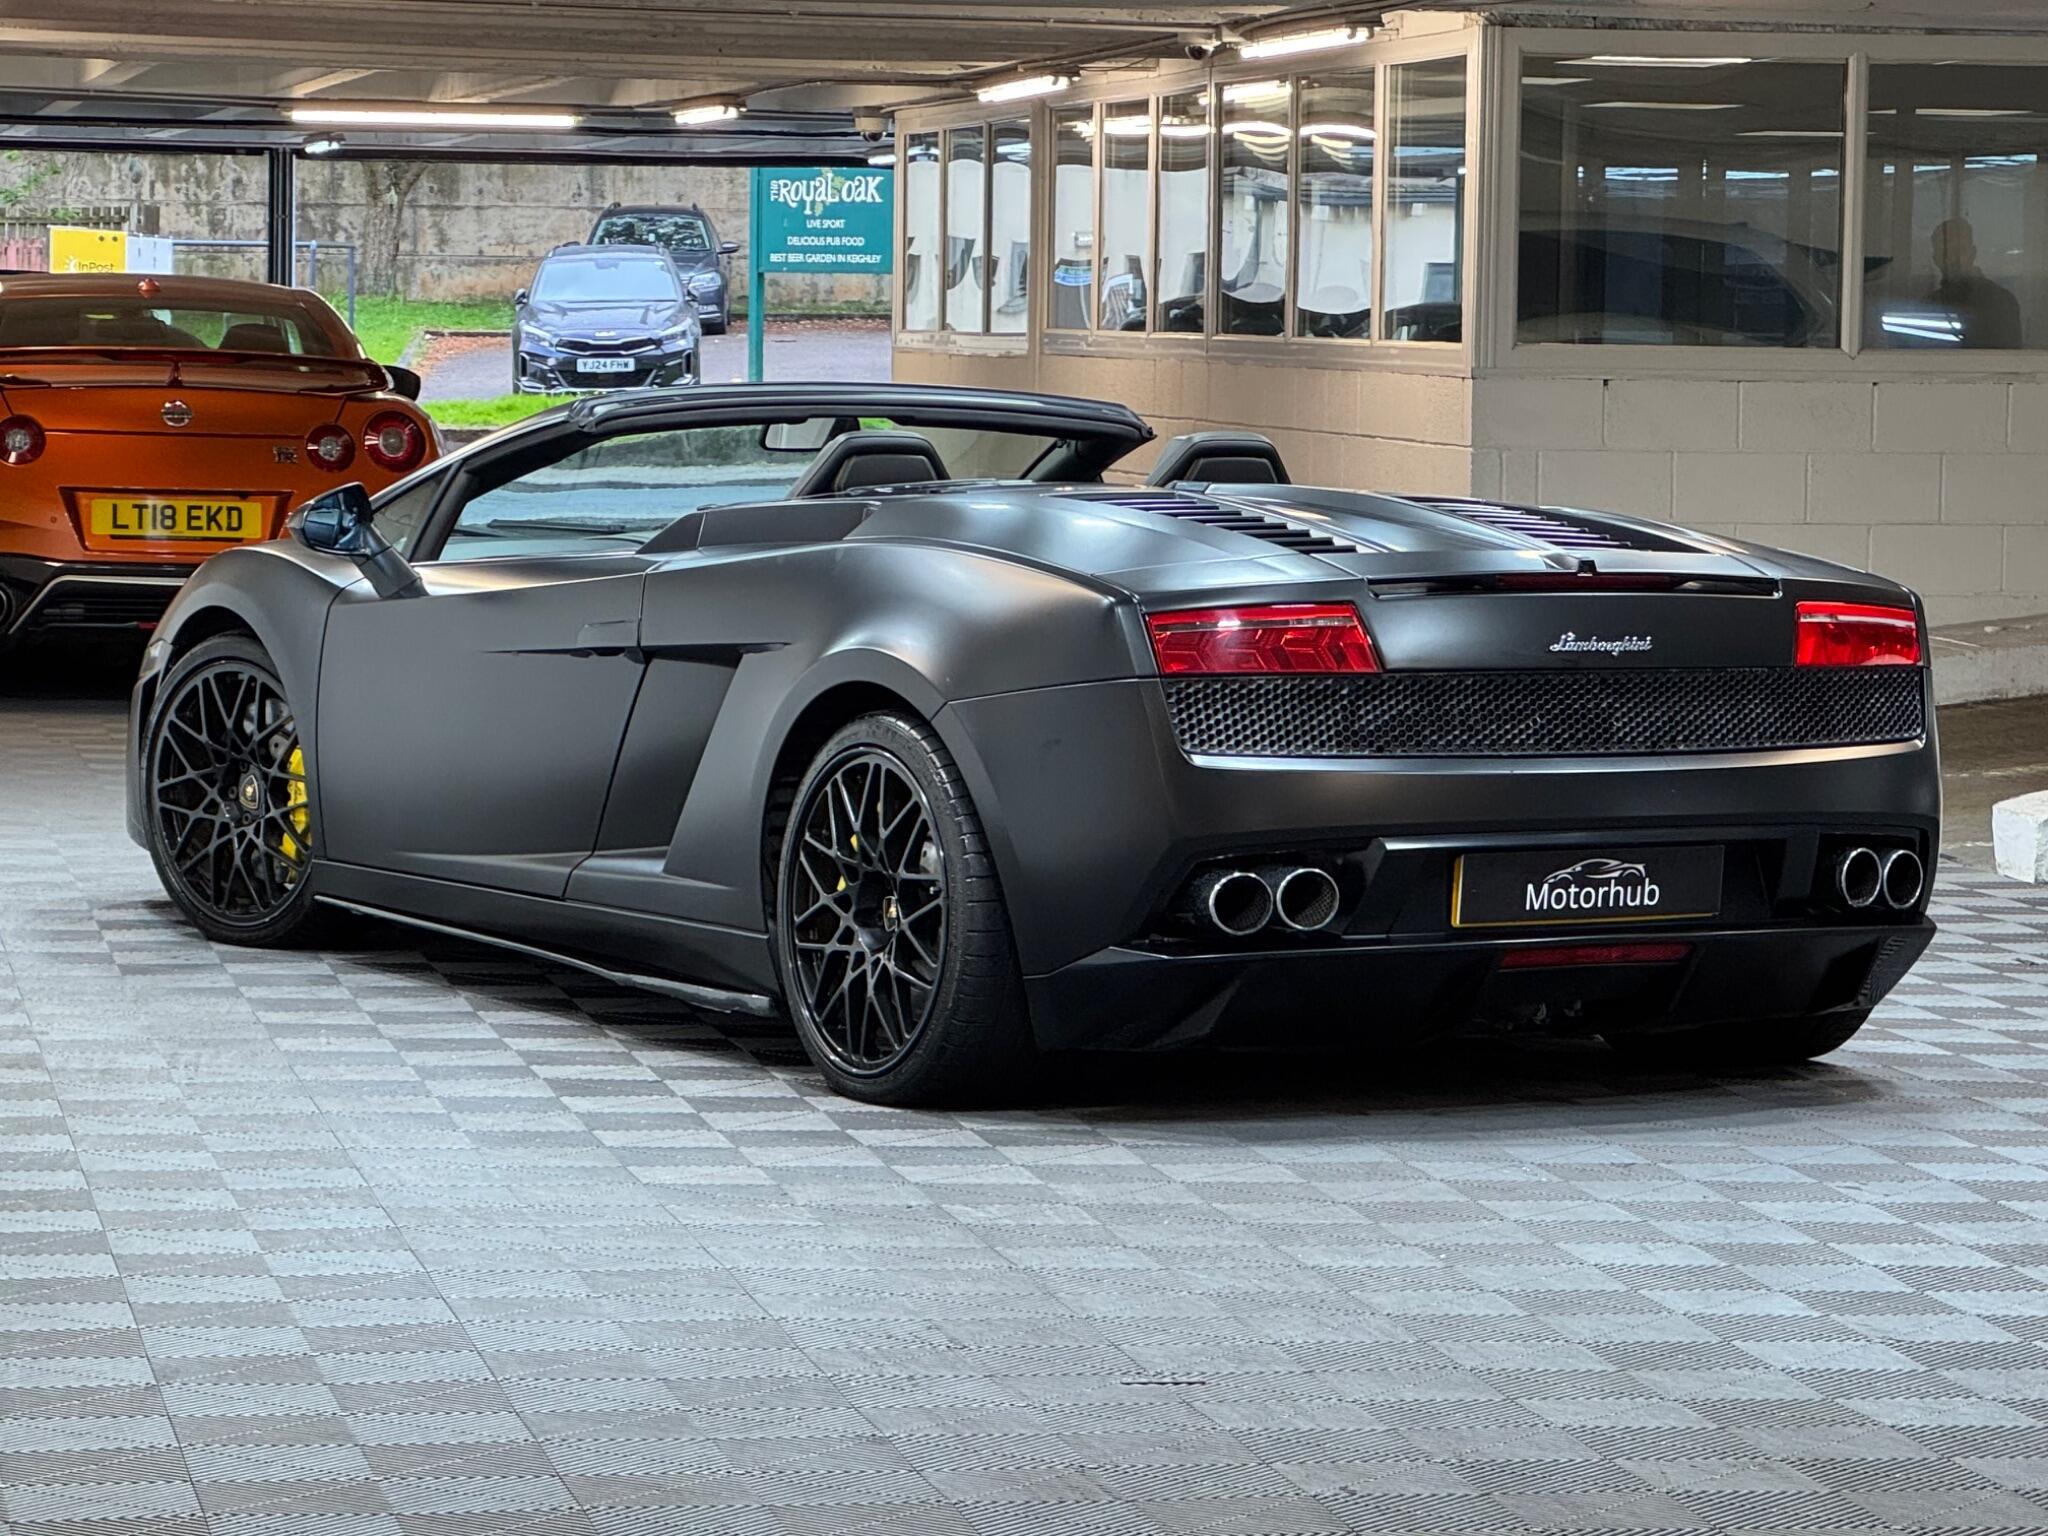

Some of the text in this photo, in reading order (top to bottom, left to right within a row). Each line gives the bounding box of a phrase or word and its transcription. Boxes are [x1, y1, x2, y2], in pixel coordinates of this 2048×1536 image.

[806, 219, 846, 228] LIVE SPORT
[787, 236, 865, 246] DELICIOUS PUB FOOD
[770, 253, 882, 263] BEST BEER GARDEN IN KEIGHLEY
[78, 262, 115, 272] InPost
[582, 360, 630, 370] YJ24 FHW
[112, 503, 242, 532] LT18 EKD
[1549, 631, 1653, 657] Lamborghini
[1525, 877, 1661, 911] Motorhub
